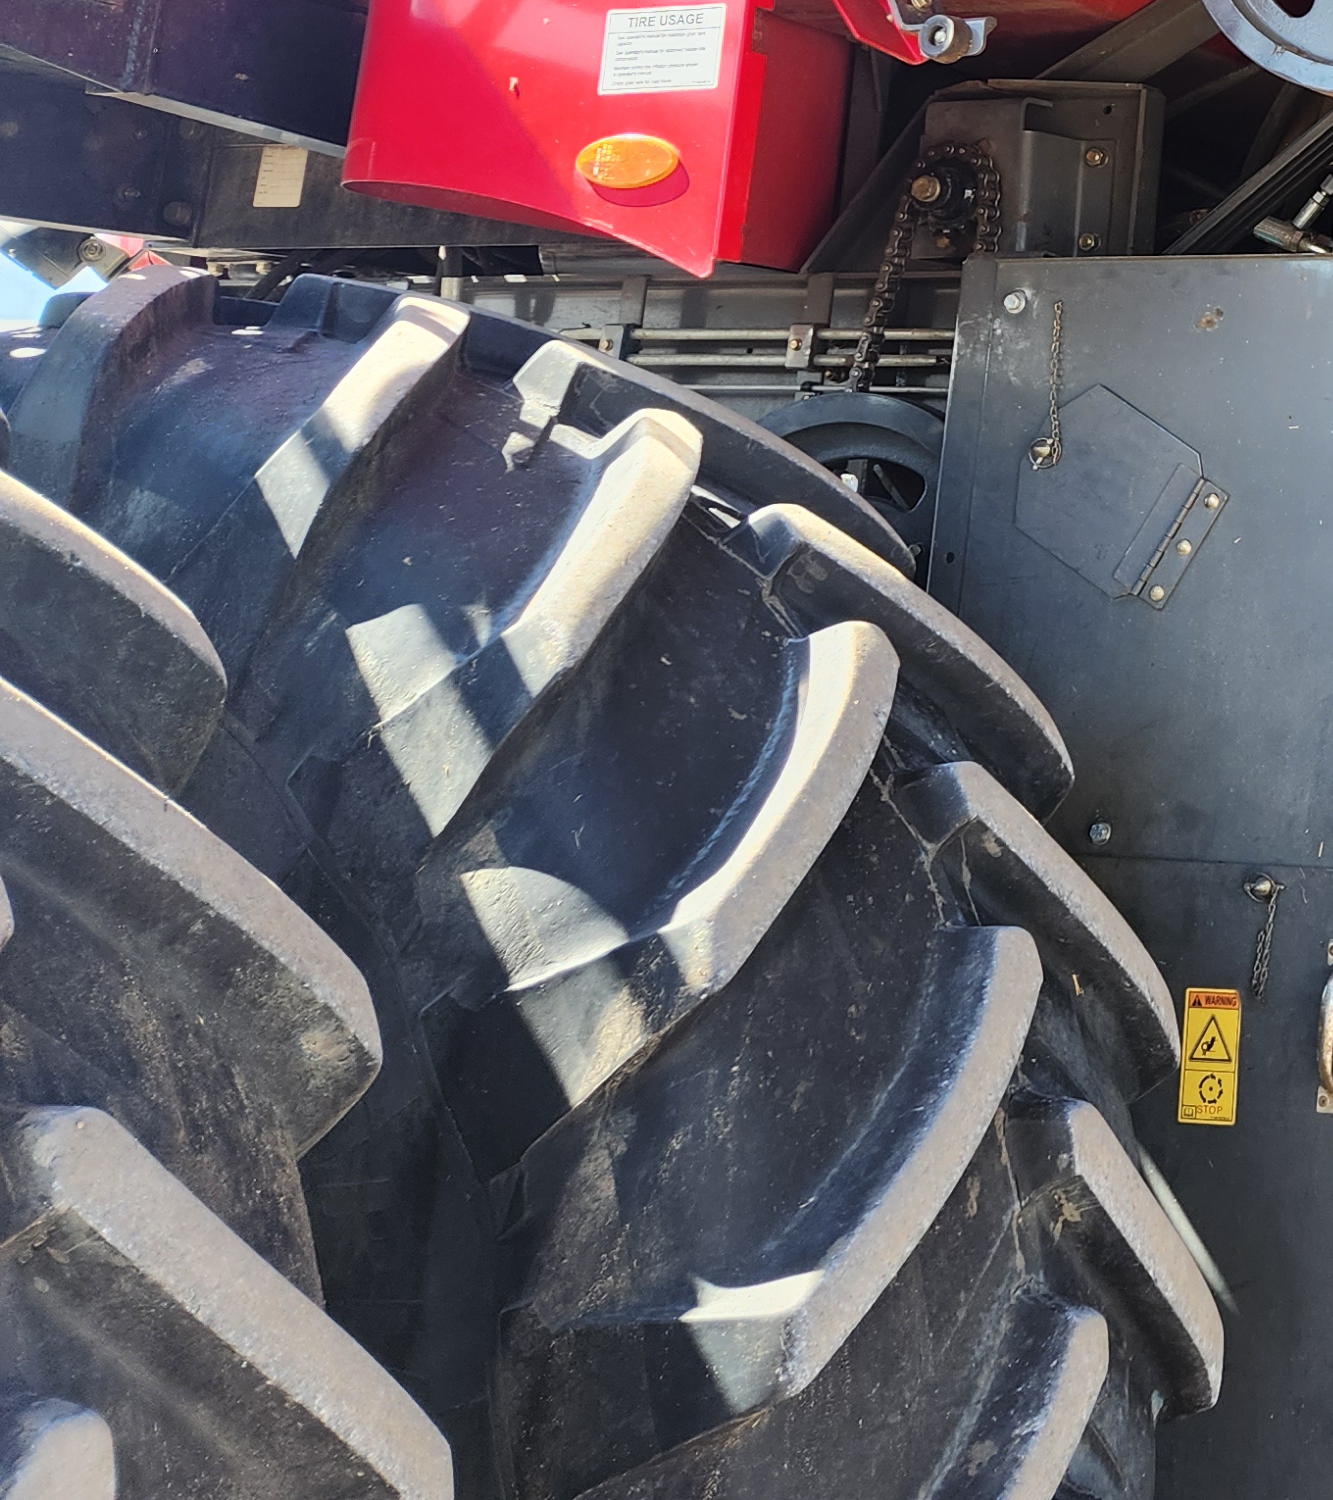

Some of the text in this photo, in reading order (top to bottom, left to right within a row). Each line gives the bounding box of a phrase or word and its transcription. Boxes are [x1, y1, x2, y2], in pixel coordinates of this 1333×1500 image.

[628, 13, 704, 28] TIRE USAGE
[1204, 994, 1237, 1006] WARNING
[1197, 1104, 1223, 1114] STOP
